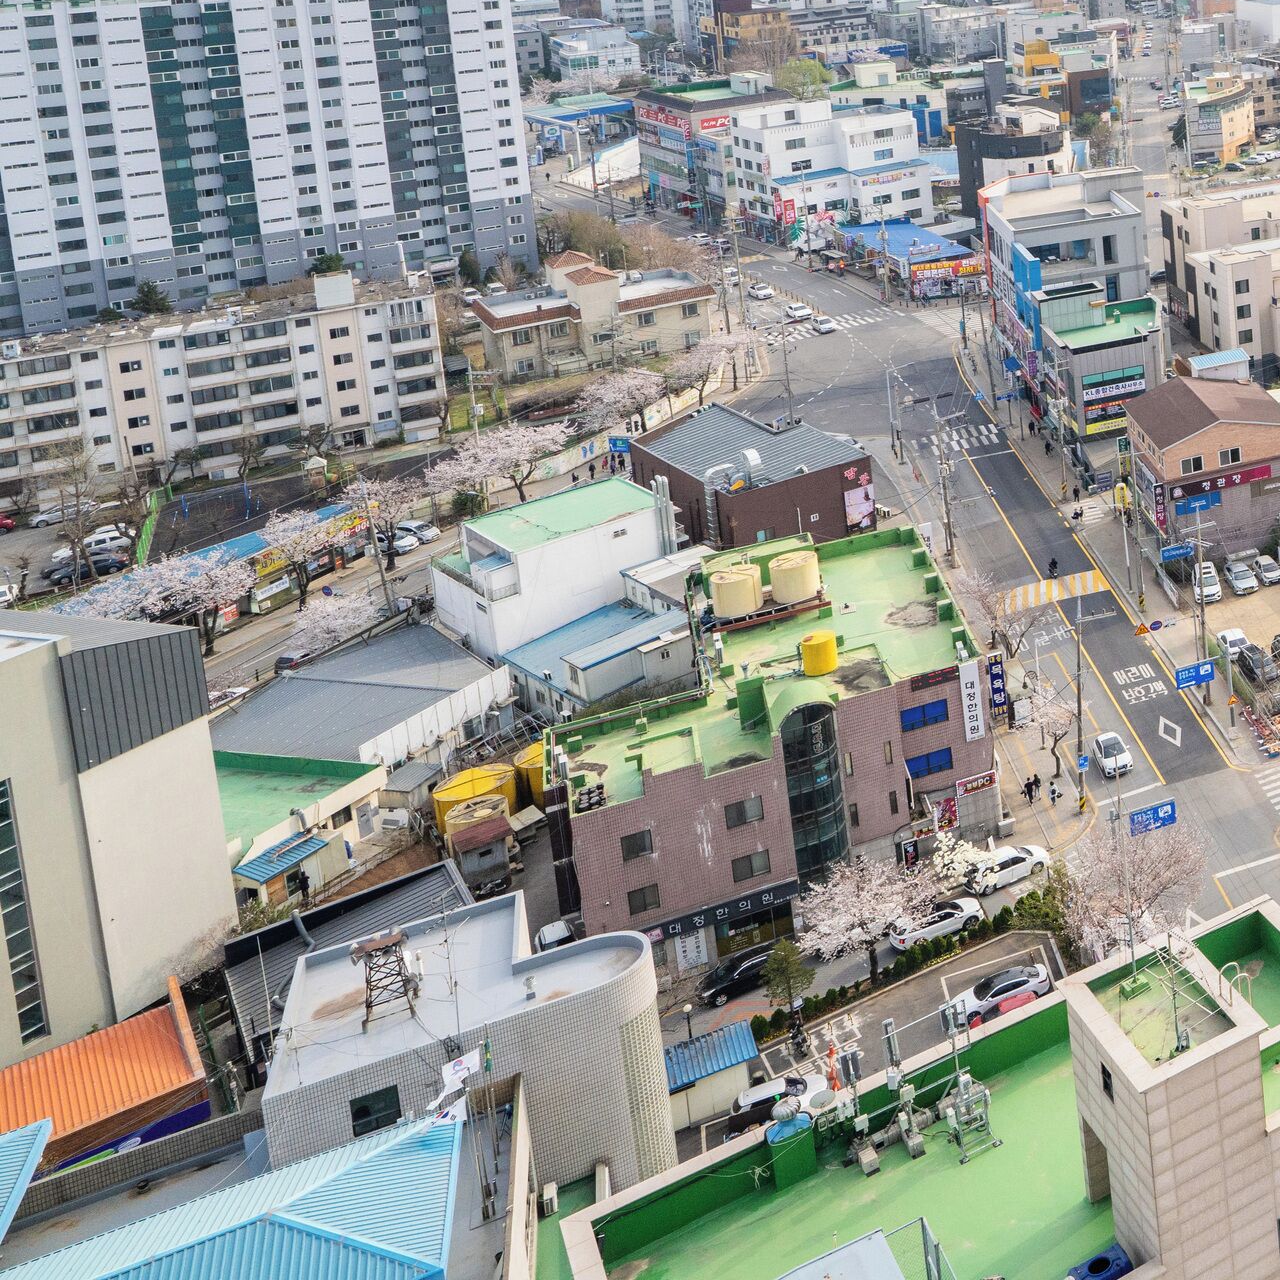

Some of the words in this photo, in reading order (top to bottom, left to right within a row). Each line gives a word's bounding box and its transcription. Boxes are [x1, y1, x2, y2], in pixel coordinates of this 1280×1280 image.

[1202, 474, 1241, 491] 정관장
[992, 665, 1007, 704] 목욕탕
[1113, 663, 1156, 685] 어린이
[965, 680, 980, 735] 대정한의원
[1122, 680, 1168, 705] 보호구역
[669, 892, 774, 934] 대정한의원
